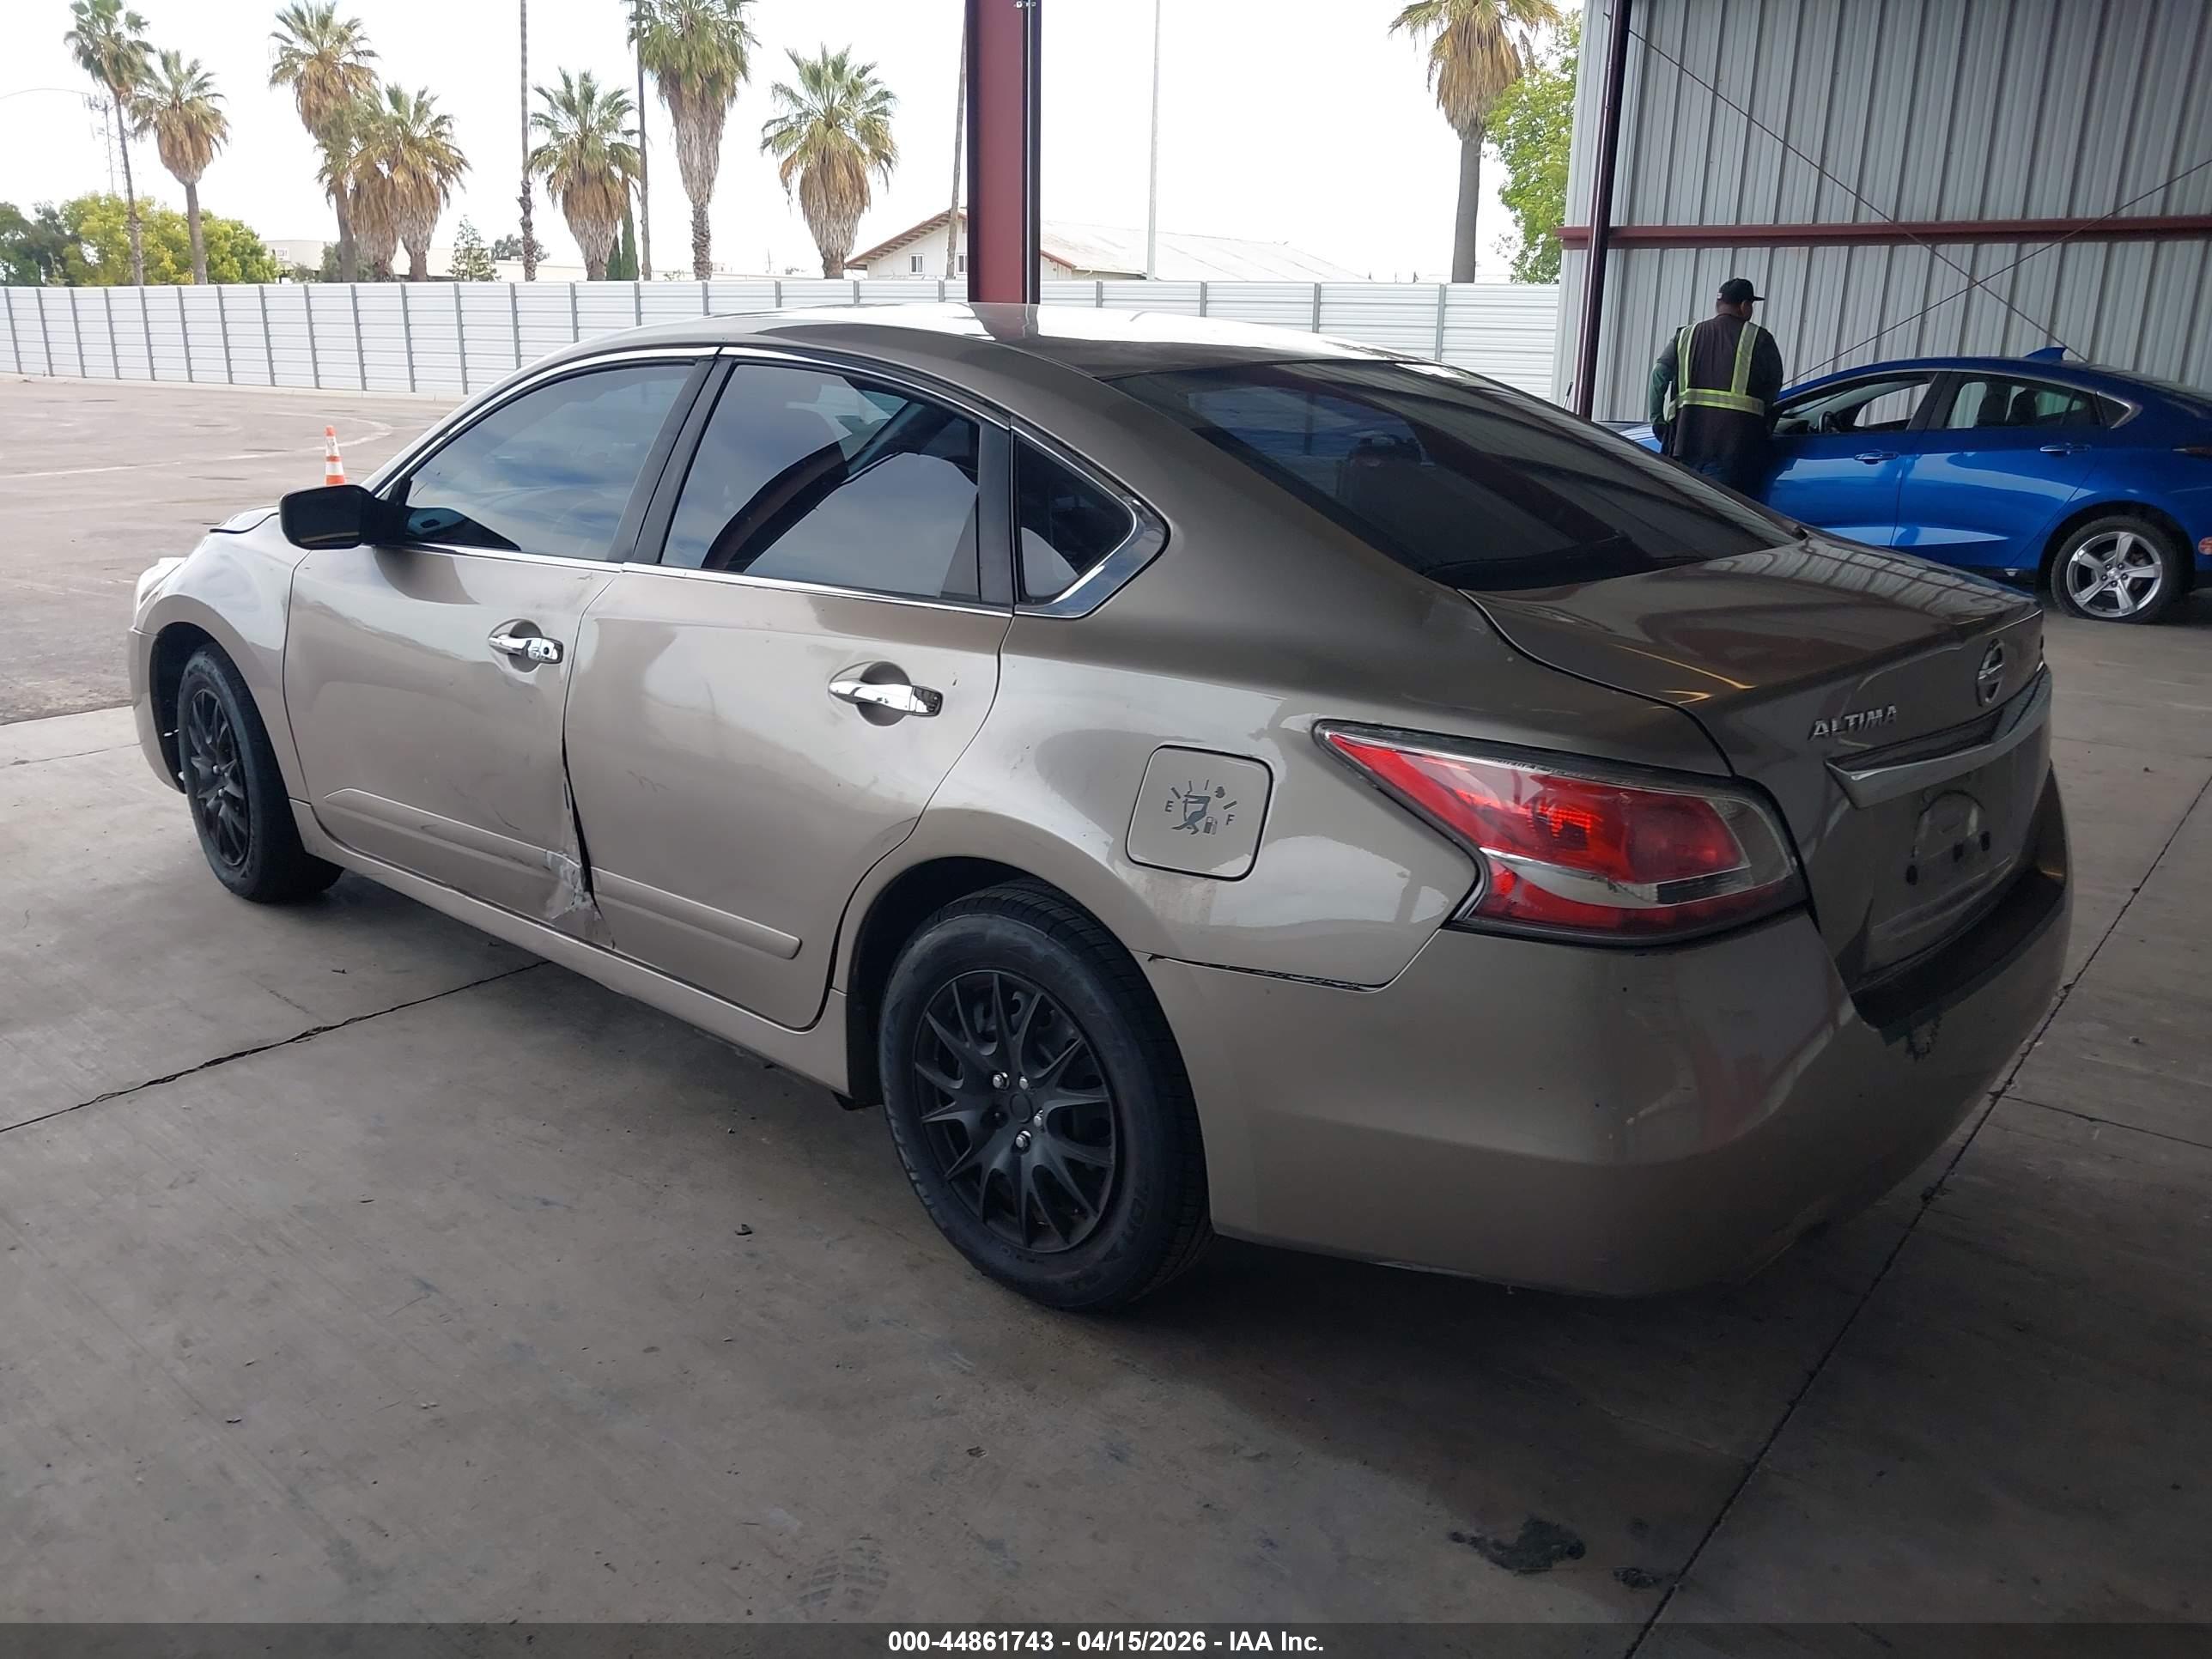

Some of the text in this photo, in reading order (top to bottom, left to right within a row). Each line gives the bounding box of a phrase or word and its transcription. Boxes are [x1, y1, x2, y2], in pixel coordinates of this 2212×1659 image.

[1808, 704, 1897, 738] ALTIMA
[1164, 799, 1175, 812] E
[1225, 814, 1236, 826] F
